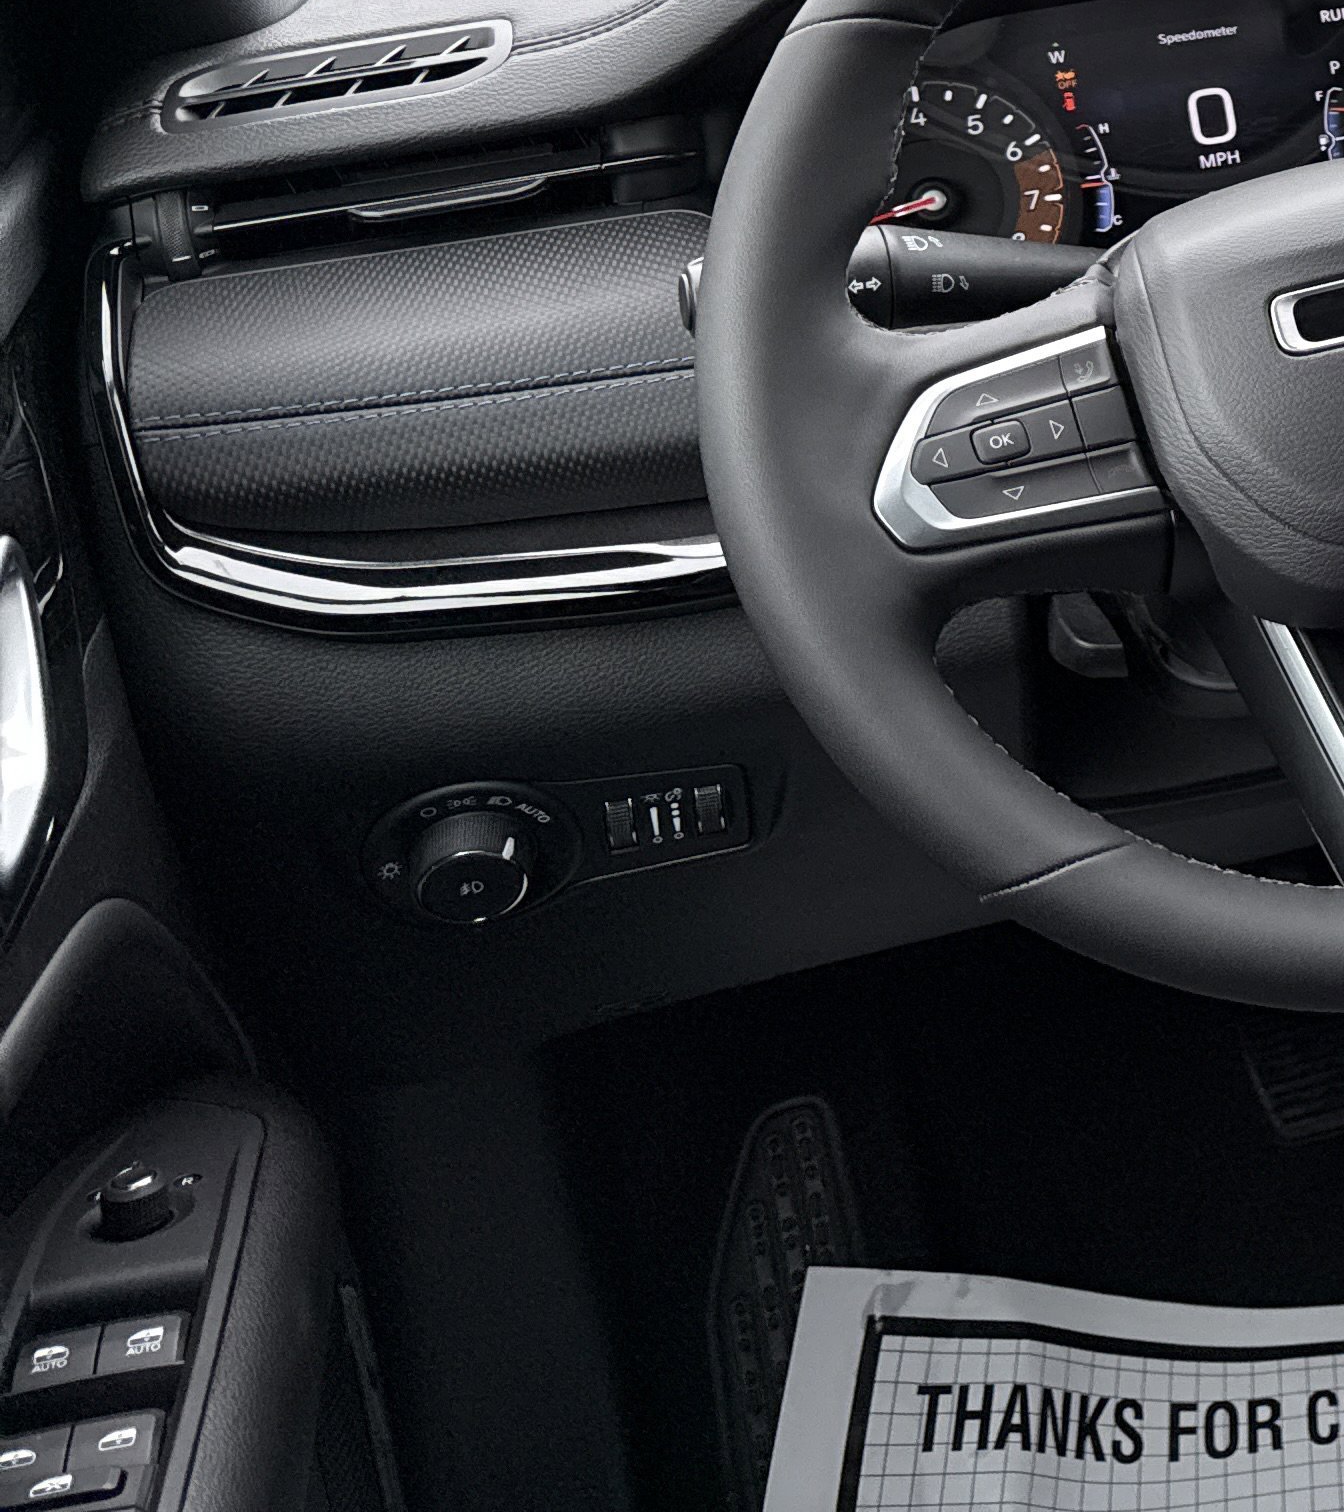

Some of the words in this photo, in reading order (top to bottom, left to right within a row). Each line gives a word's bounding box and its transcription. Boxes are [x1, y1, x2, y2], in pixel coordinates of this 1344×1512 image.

[1156, 25, 1239, 46] Speedometer
[1047, 49, 1066, 65] W
[1328, 59, 1341, 75] P
[1314, 90, 1324, 102] F
[909, 107, 927, 127] 4
[966, 113, 984, 135] 5
[1186, 86, 1237, 146] 0
[1098, 122, 1110, 135] H
[1005, 141, 1022, 162] 6
[1197, 149, 1241, 170] MPH
[1023, 189, 1040, 211] 7
[1112, 214, 1124, 226] C
[989, 432, 1015, 449] OK
[514, 803, 551, 823] AUTO
[125, 1343, 161, 1357] AUTO
[31, 1359, 68, 1374] AUTO
[916, 1384, 1143, 1465] THANKS
[1168, 1397, 1284, 1463] FOR
